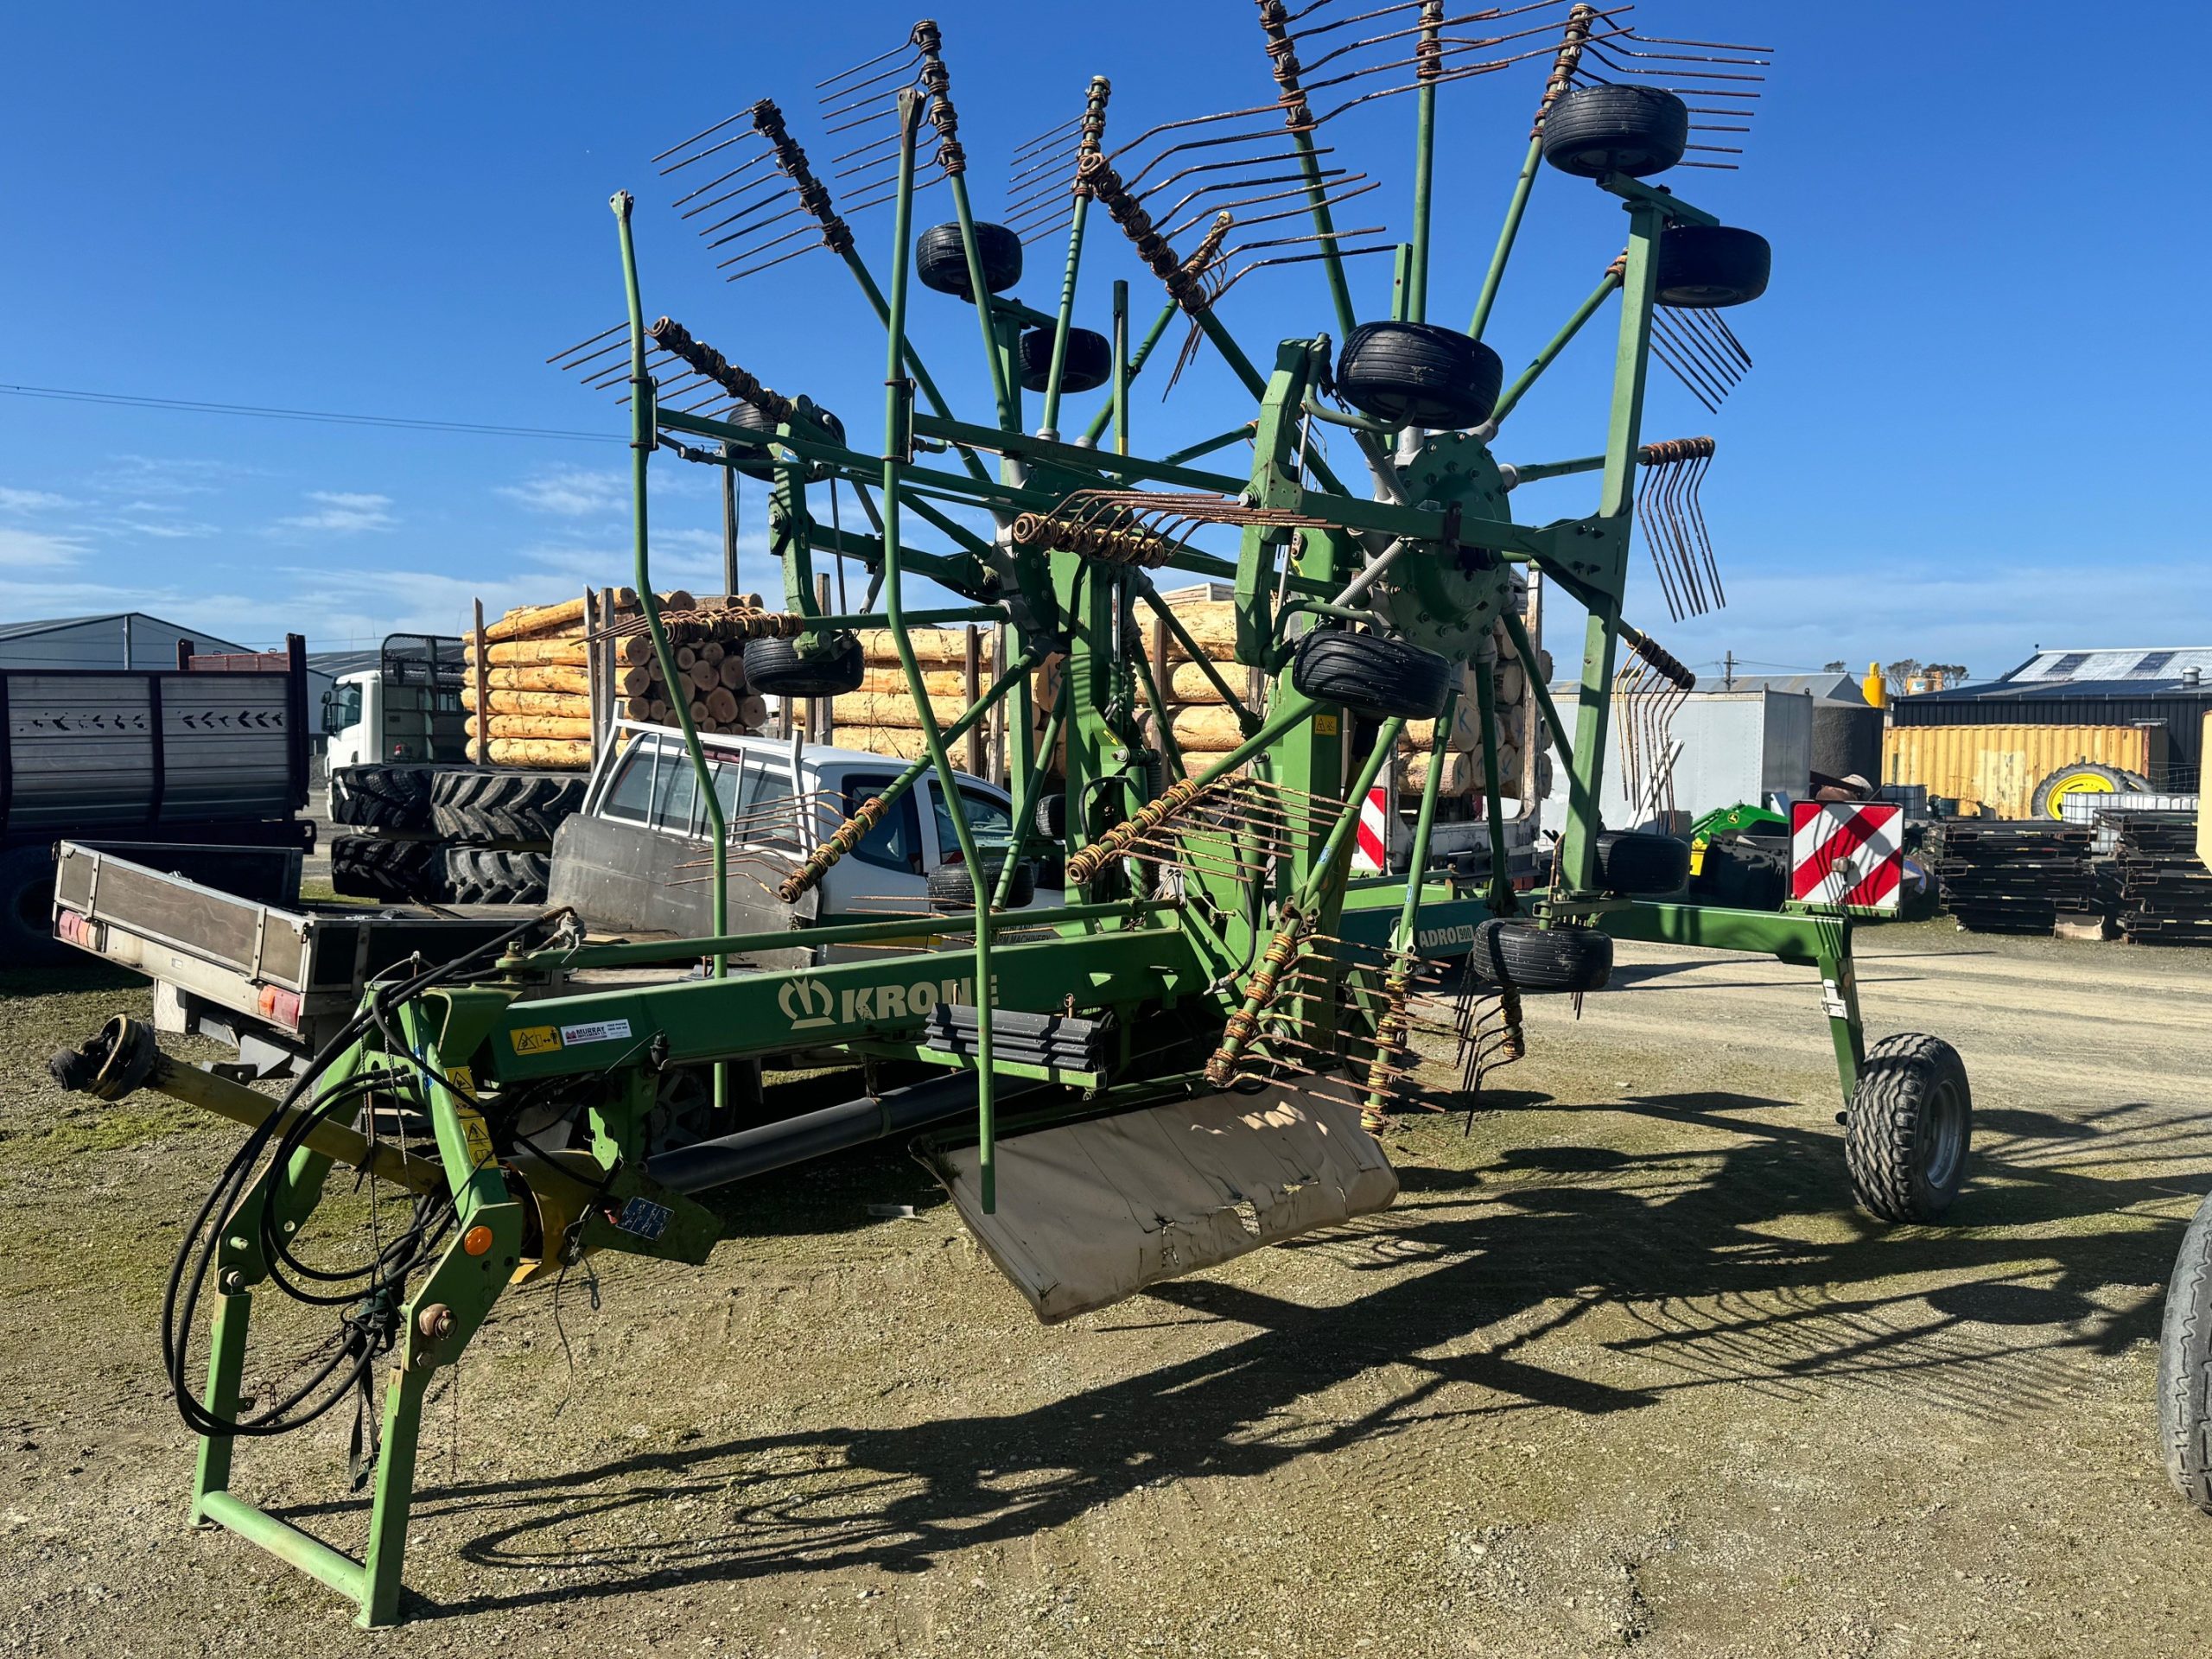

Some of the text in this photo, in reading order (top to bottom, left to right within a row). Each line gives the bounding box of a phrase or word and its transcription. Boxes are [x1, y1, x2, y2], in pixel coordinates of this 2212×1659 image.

[1458, 705, 1472, 734] K
[1456, 761, 1465, 785] K
[1009, 934, 1051, 944] MACHINERY
[1419, 925, 1472, 948] ADRO 900
[576, 1027, 604, 1035] MURRAY
